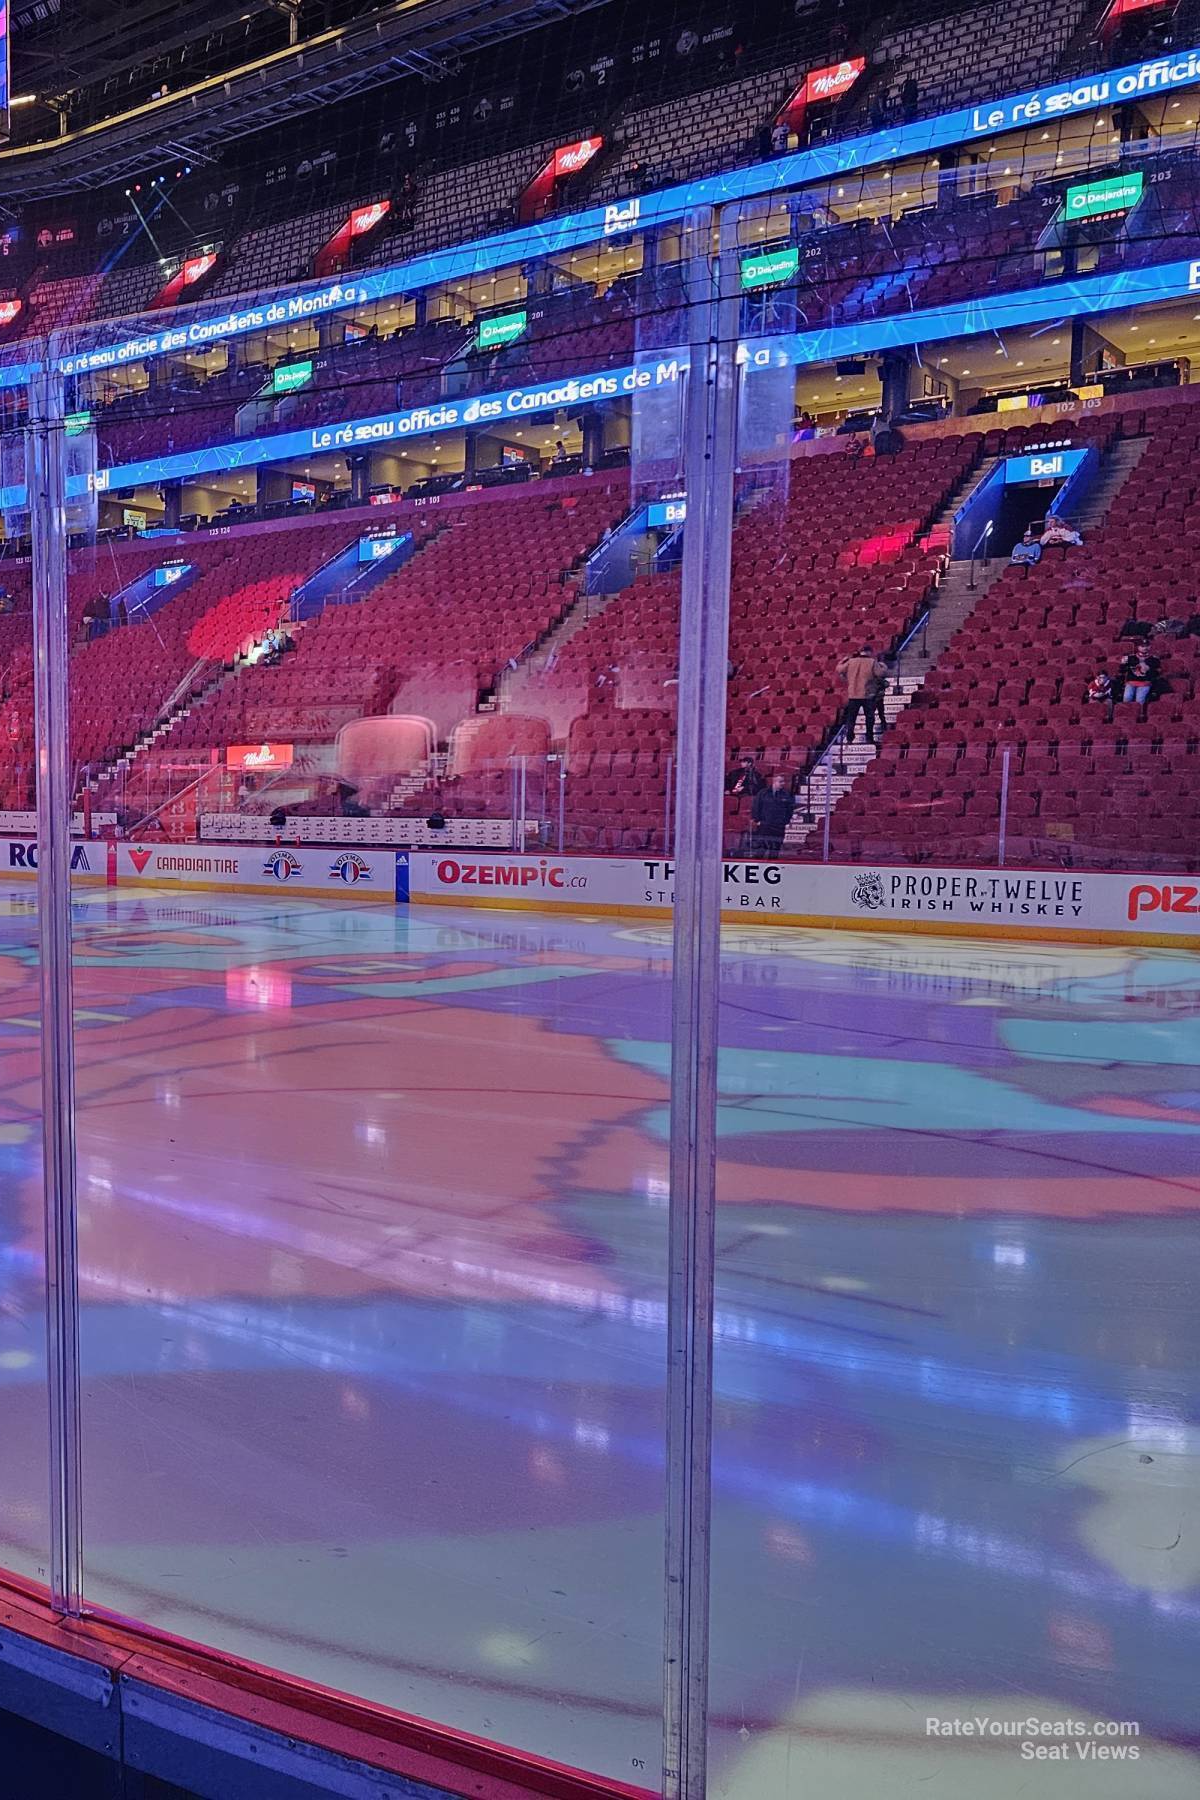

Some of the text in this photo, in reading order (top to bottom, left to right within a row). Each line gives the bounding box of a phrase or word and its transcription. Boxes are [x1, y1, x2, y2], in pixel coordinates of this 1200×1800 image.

[972, 109, 1004, 131] Le
[1117, 53, 1200, 94] offici
[1150, 170, 1172, 184] 203
[1087, 185, 1138, 206] Desjardins
[604, 198, 641, 235] Bell
[805, 247, 822, 259] 202
[531, 311, 544, 321] 201
[161, 331, 187, 350] des
[267, 304, 285, 321] de
[312, 431, 331, 449] Le
[463, 399, 503, 422] des
[506, 377, 618, 412] Canadiens
[622, 368, 650, 390] de
[1056, 397, 1102, 413] 102 103
[1030, 455, 1063, 476] Bell
[87, 469, 110, 491] Bell
[9, 842, 91, 871] ROA
[156, 856, 239, 874] CANADIAN TIRE
[269, 850, 295, 866] OLYMEL
[337, 851, 364, 867] OLYMEL
[644, 861, 782, 884] TH KEG
[644, 890, 676, 903] STE
[740, 895, 782, 908] BAR
[891, 875, 1083, 902] PROPER TWELVE
[891, 897, 1083, 917] IRISH WHISKEY
